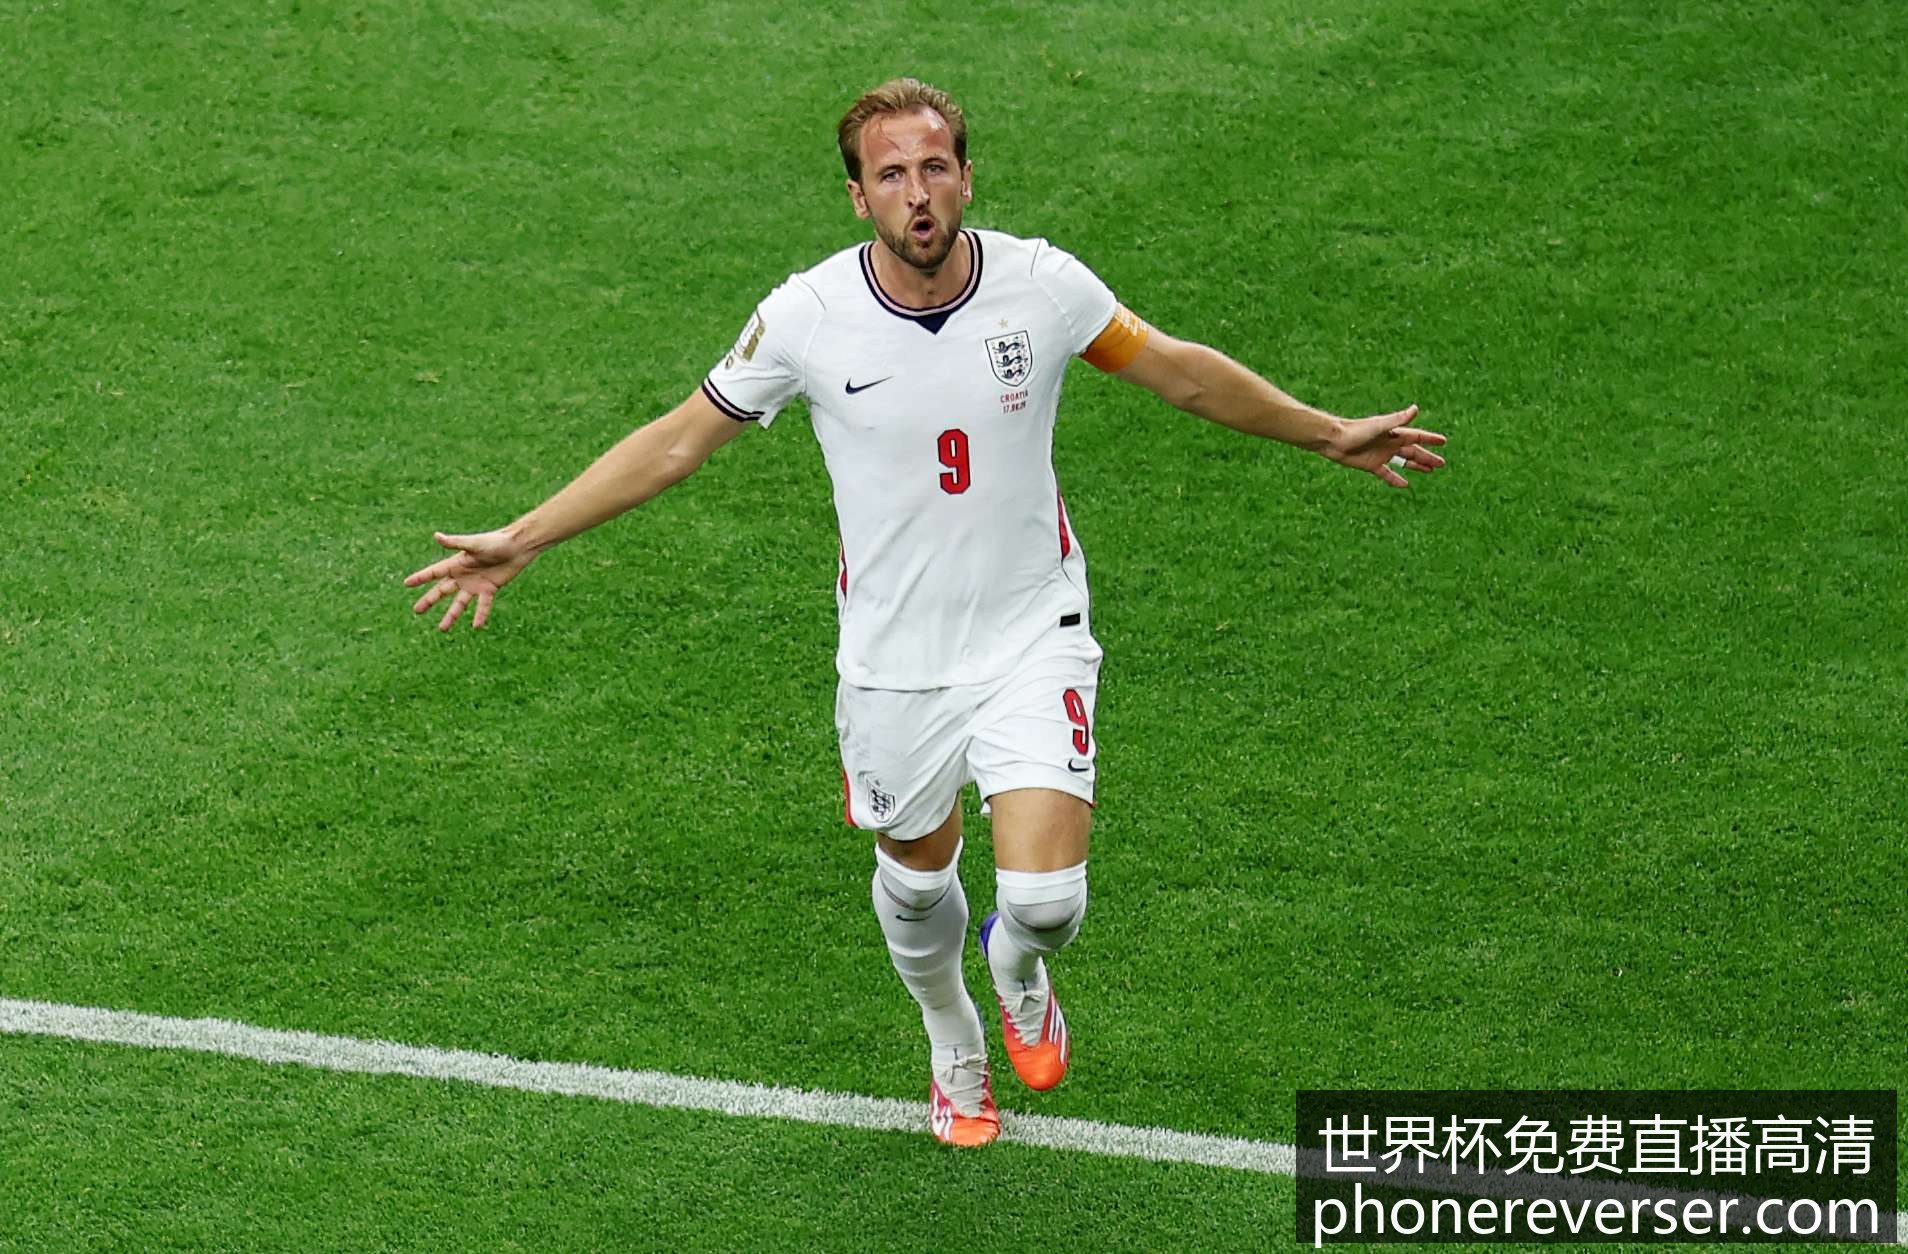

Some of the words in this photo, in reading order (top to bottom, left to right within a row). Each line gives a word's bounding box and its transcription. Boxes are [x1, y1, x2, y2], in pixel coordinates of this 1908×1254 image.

[1000, 389, 1029, 403] CROATIA
[937, 429, 971, 494] 9
[1063, 688, 1089, 756] 9
